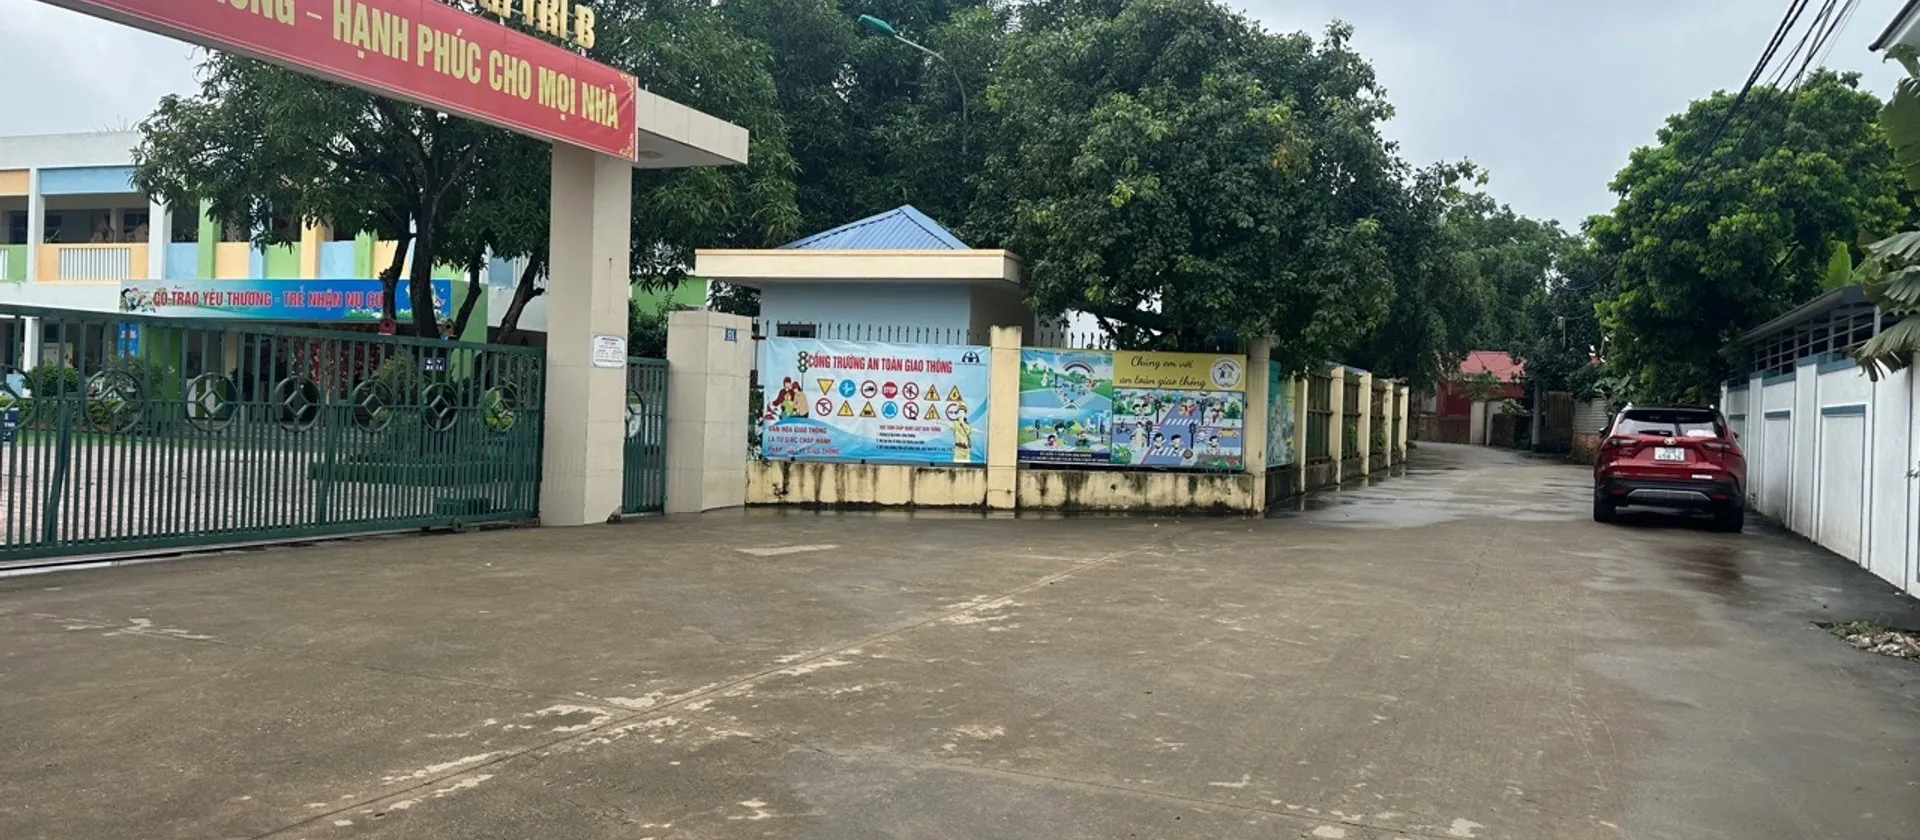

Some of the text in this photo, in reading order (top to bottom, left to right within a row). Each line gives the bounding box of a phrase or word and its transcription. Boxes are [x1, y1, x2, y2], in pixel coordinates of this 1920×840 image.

[574, 4, 595, 49] B
[333, 0, 409, 62] HẠNH
[417, 23, 482, 84] PHÚC
[488, 49, 531, 100] CHO
[538, 66, 576, 120] MỌI
[581, 82, 619, 129] NHÀ
[171, 291, 199, 306] TRAO
[283, 286, 305, 308] TRẺ
[808, 352, 953, 374] CỔNG TRƯỜNG AN TOÀN GIAO THÔNG
[1131, 355, 1160, 370] Chúng
[1158, 376, 1177, 388] giao
[1179, 375, 1206, 388] thông
